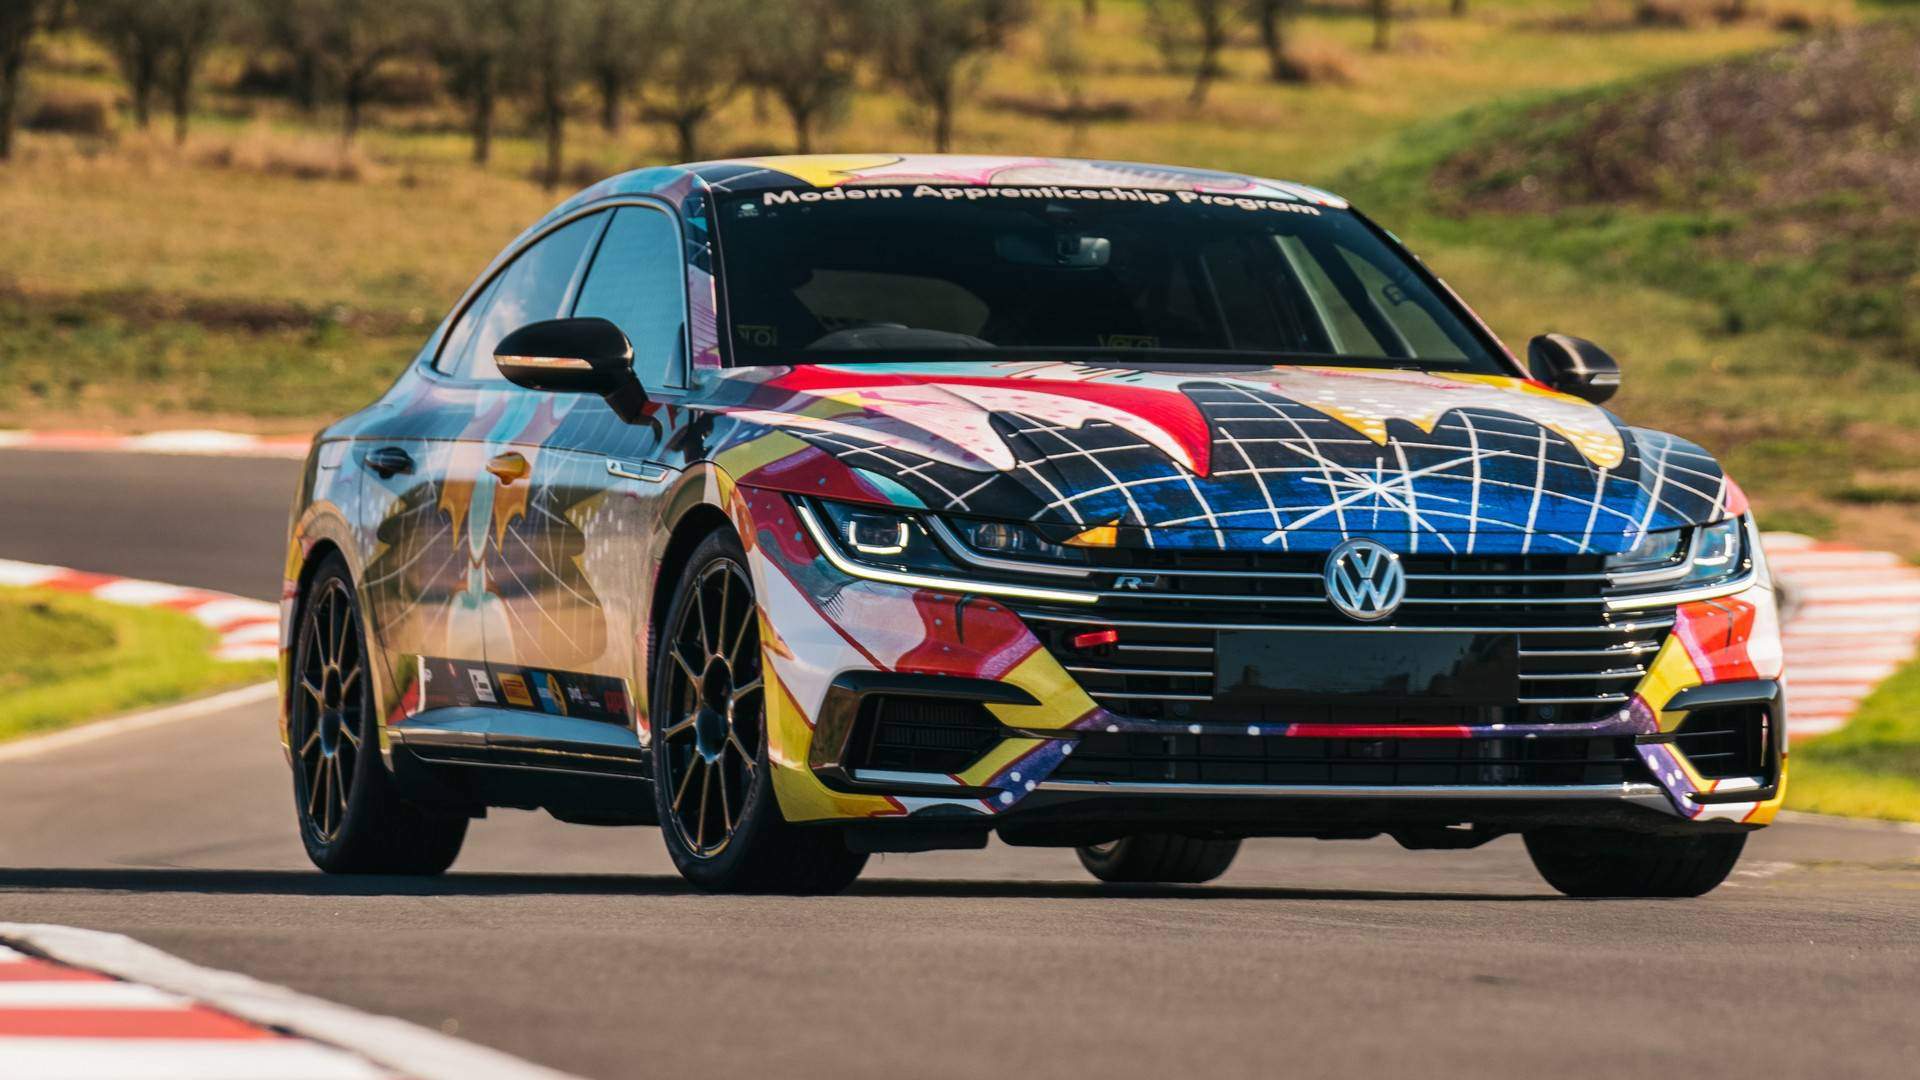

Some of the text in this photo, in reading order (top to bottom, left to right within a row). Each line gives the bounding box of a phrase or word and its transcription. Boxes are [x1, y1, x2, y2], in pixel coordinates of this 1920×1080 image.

[763, 184, 1322, 216] Modern Apprenticeship Program
[1334, 548, 1401, 612] VW
